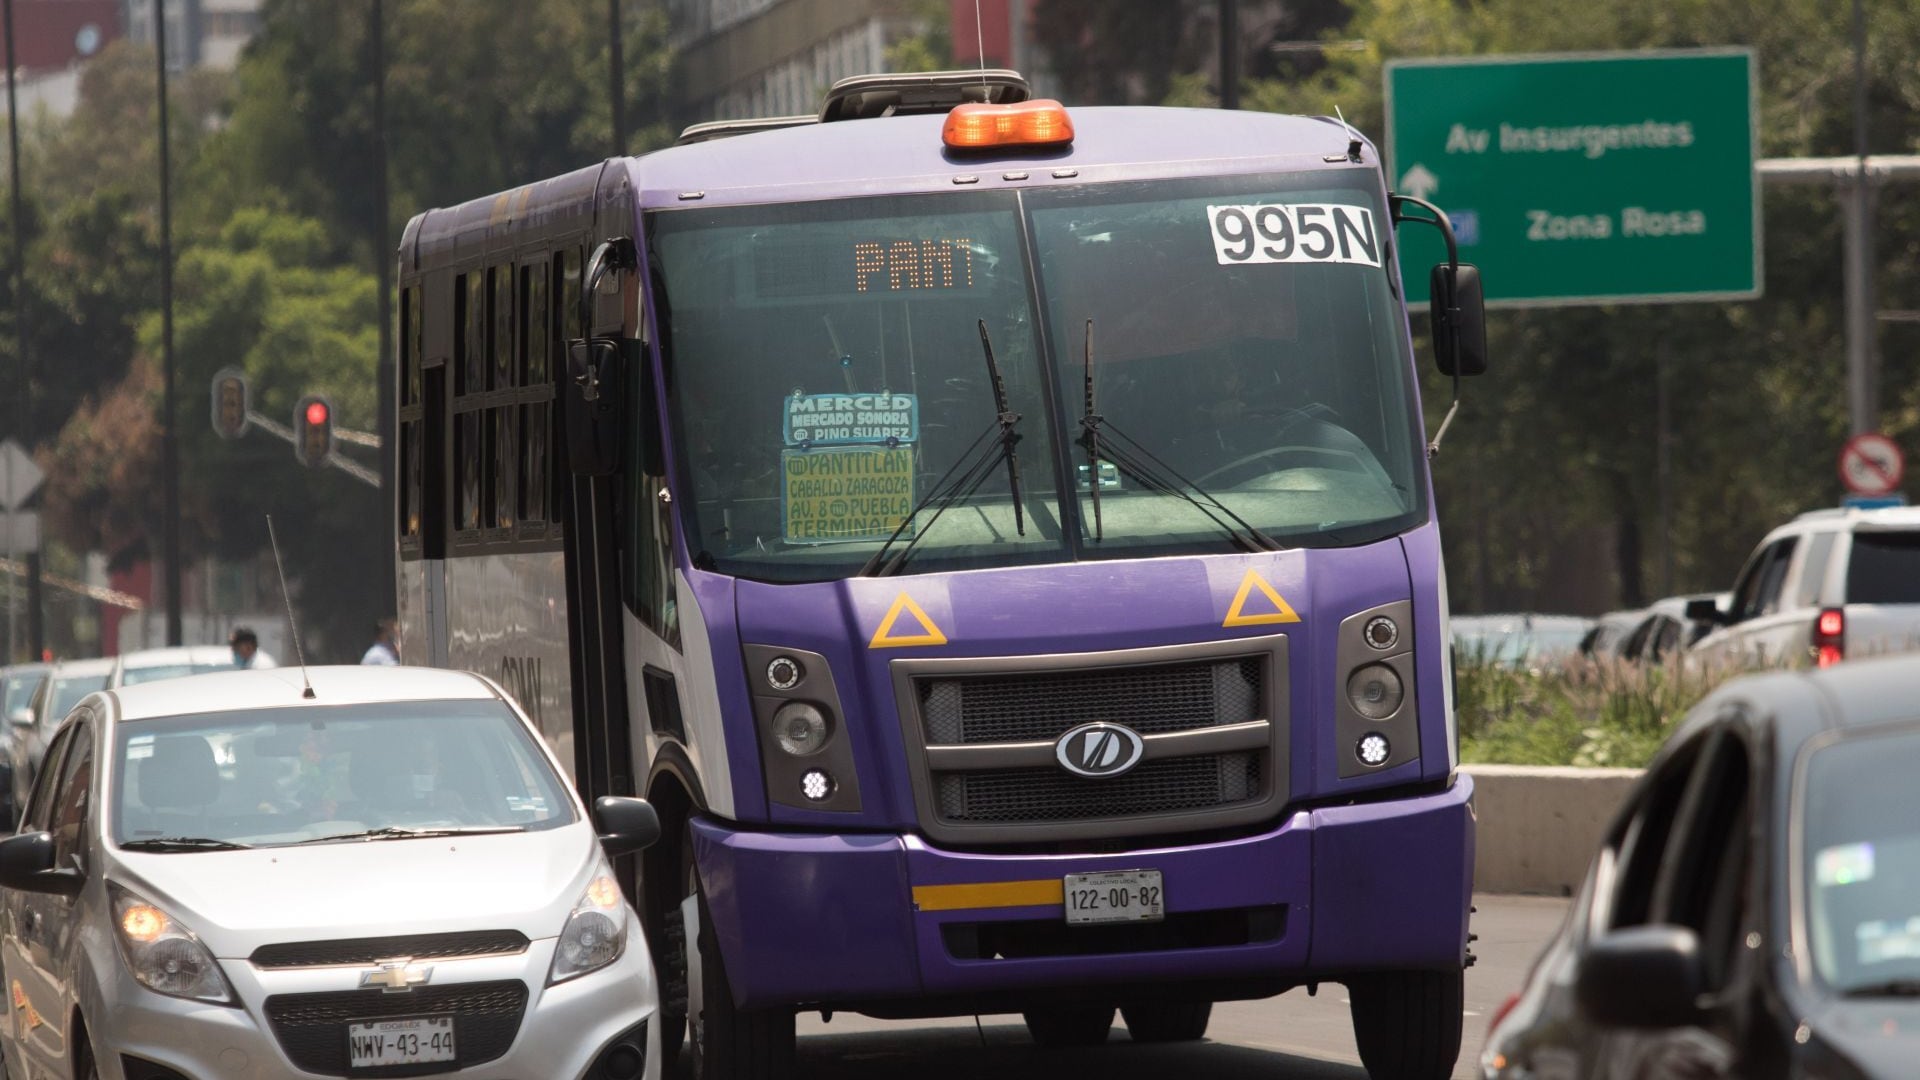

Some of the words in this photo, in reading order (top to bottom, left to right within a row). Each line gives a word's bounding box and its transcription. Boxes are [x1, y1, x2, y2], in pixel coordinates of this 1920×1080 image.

[1446, 123, 1490, 152] Av
[1500, 119, 1694, 159] Insurgentes
[1215, 206, 1379, 263] 995N
[1526, 209, 1612, 241] Zona
[1621, 206, 1706, 237] Rosa
[790, 397, 912, 413] MERCED
[792, 412, 854, 427] MERCADO
[857, 411, 909, 425] SONORA
[815, 427, 850, 440] PINO
[853, 426, 909, 439] SUAREZ
[809, 450, 908, 475] PANTITLAN
[790, 479, 843, 498] CABALLO
[847, 476, 909, 496] ZARAGOZA
[818, 501, 827, 518] 8
[851, 497, 910, 517] PUEBLA
[791, 518, 889, 537] TERMINAL
[1071, 886, 1160, 910] 122-00-82
[351, 1031, 453, 1059] NWV-43-44
